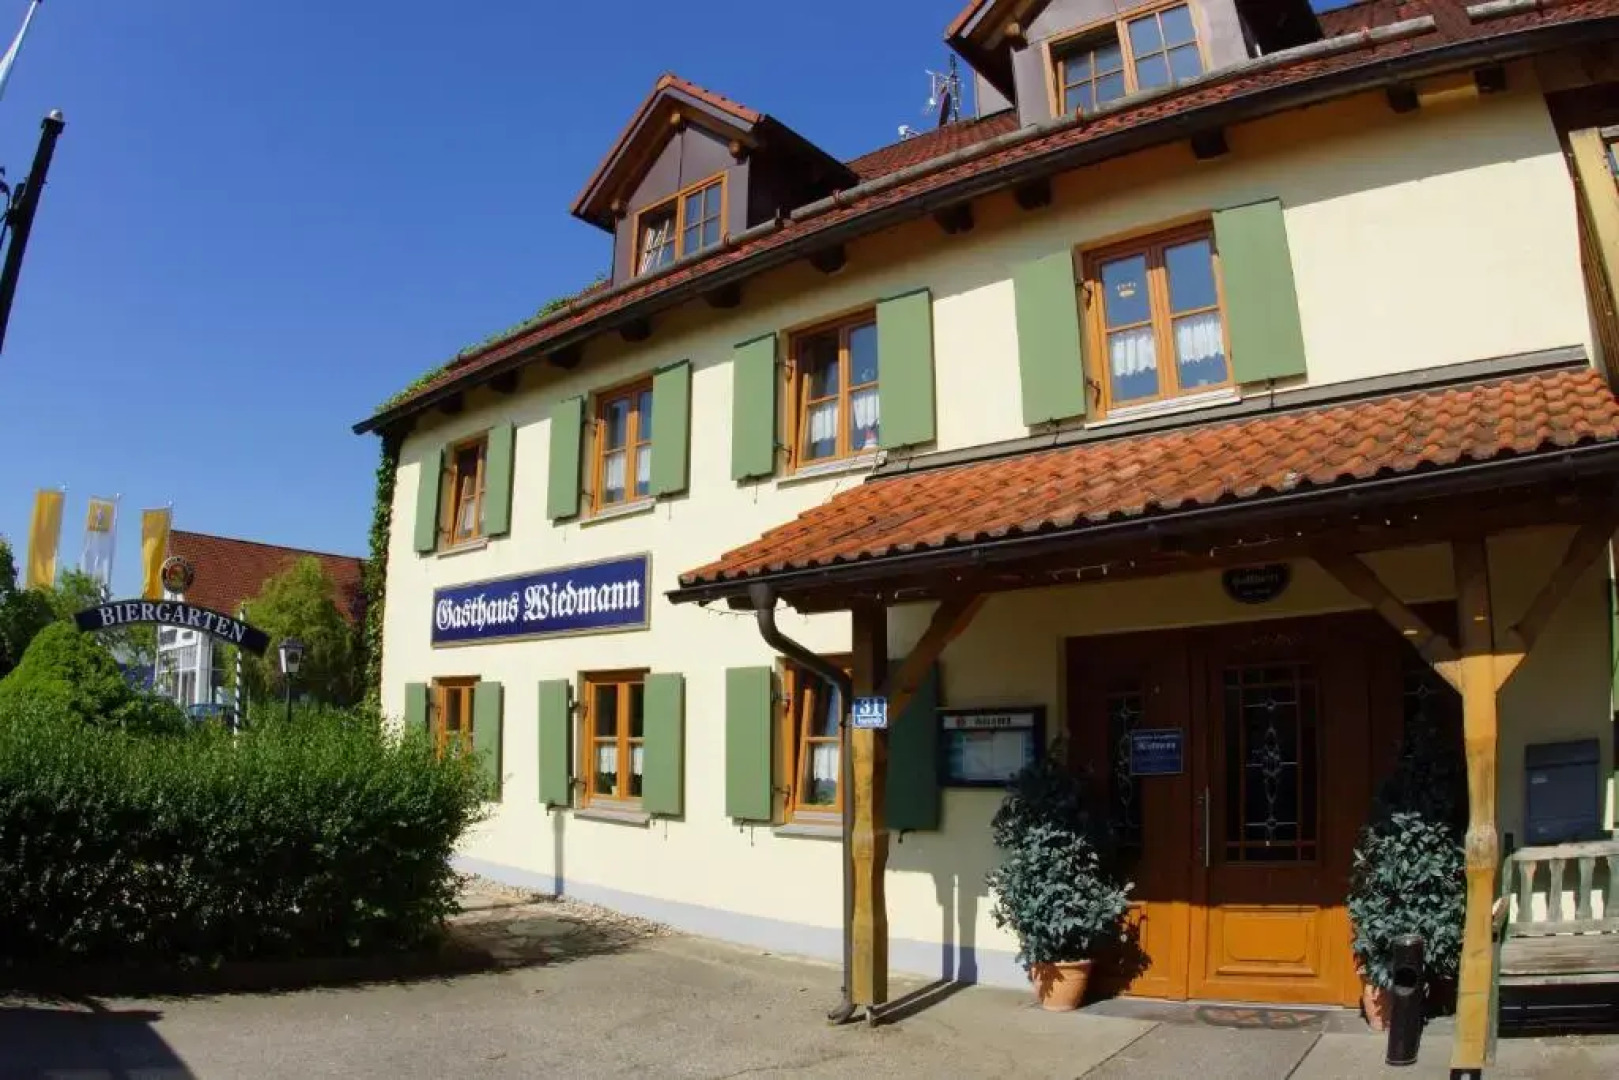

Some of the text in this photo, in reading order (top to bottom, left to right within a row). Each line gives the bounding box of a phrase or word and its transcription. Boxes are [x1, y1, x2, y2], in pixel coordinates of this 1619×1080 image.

[98, 603, 247, 643] BIERGARTEN
[435, 578, 641, 632] Gasthaus Wiedmann
